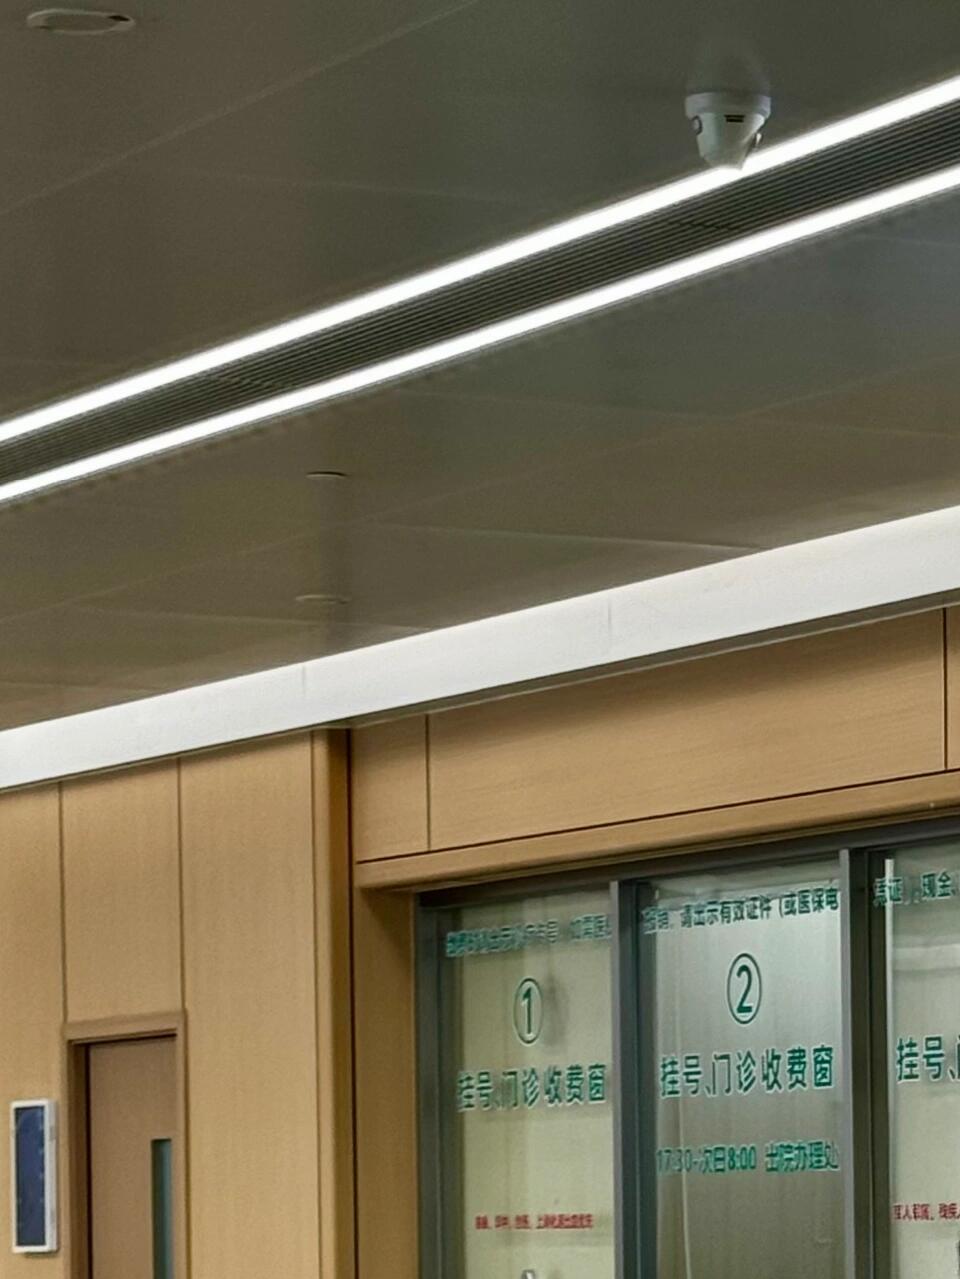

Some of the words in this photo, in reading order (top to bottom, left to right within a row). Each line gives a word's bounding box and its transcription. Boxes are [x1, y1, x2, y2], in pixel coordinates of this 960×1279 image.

[660, 1044, 834, 1096] 挂号、门诊收费窗
